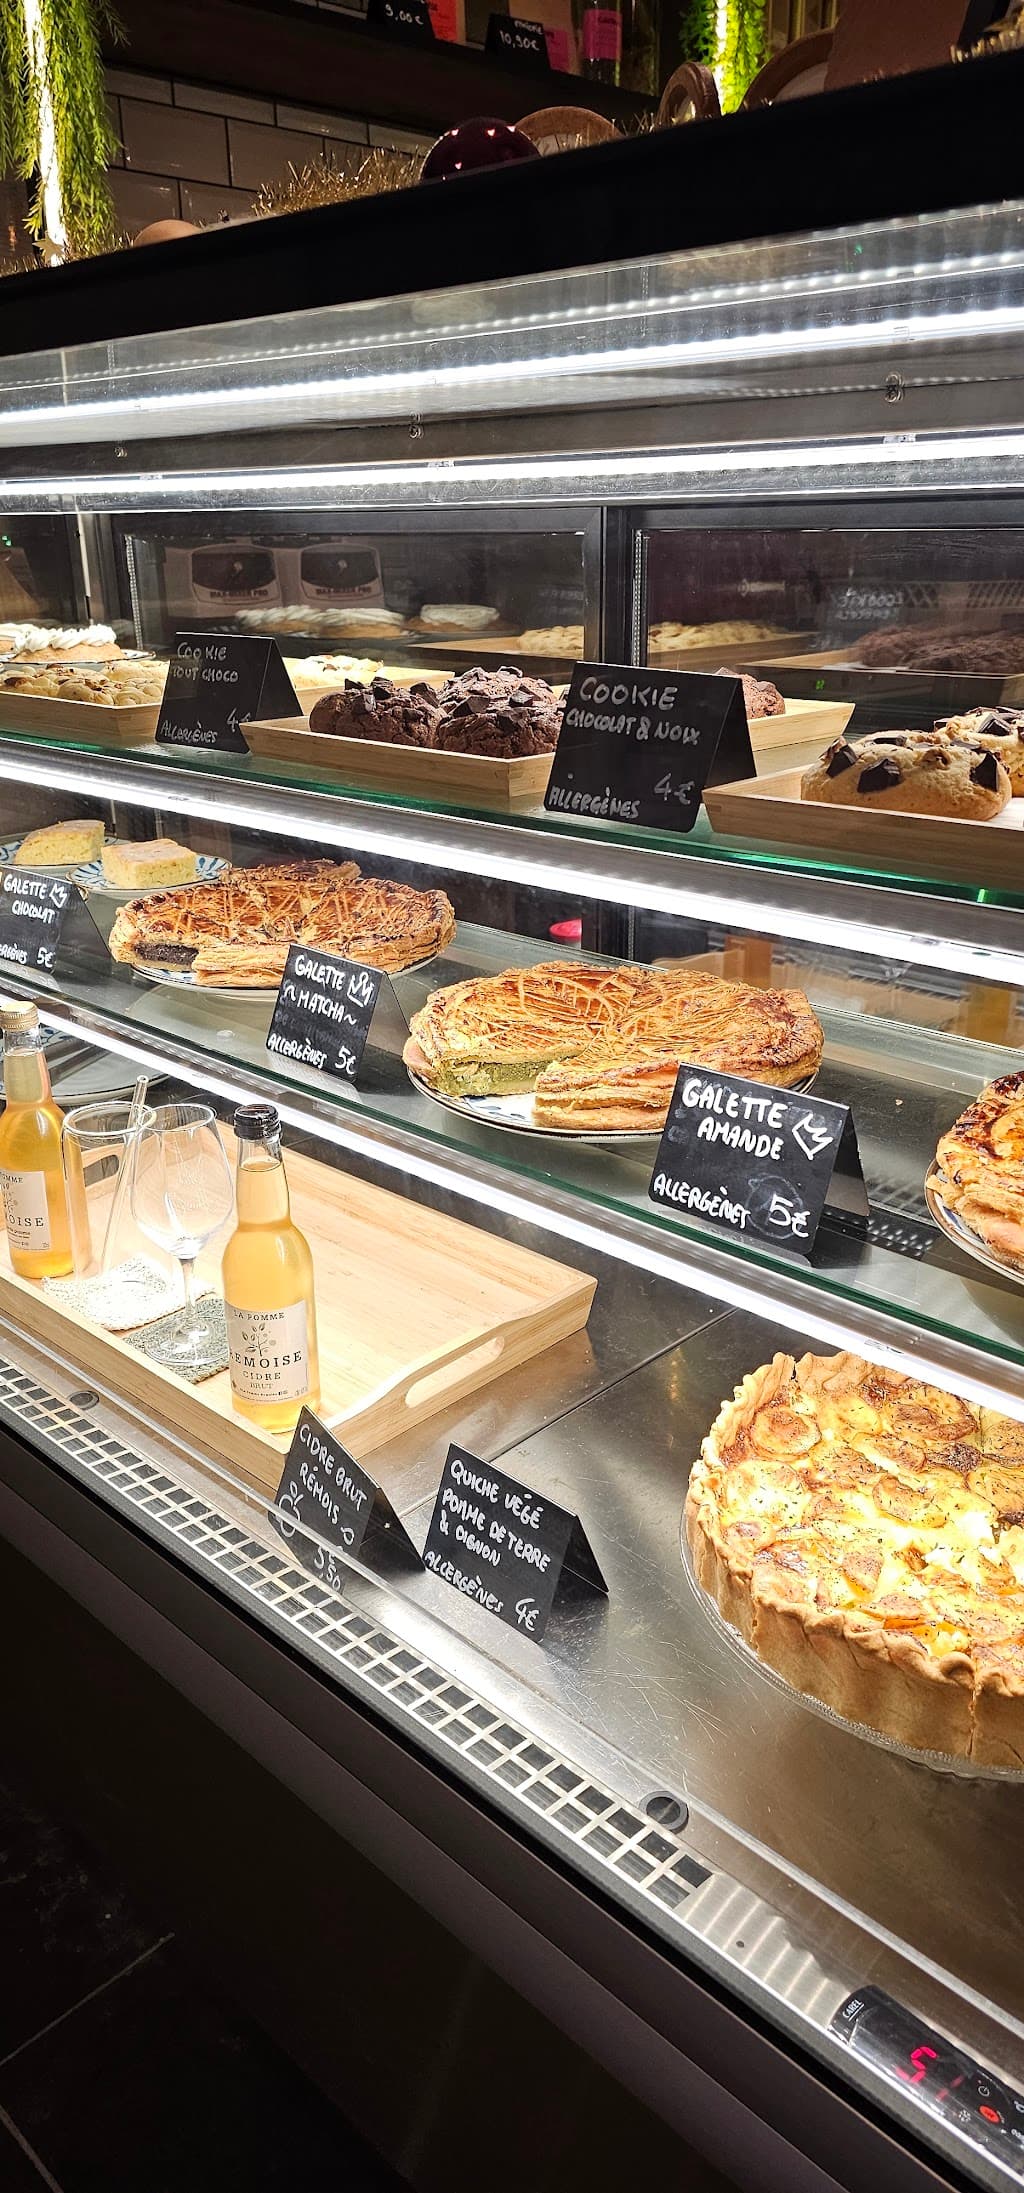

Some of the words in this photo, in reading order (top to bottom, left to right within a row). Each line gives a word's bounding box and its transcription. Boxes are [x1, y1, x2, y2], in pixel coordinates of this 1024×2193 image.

[176, 641, 228, 662] COOKIE
[170, 665, 200, 682] TOUT
[201, 667, 239, 683] CHOCO
[578, 675, 679, 711] COOKIE
[565, 706, 636, 736] CHOCOLAT
[635, 715, 651, 741] &
[654, 721, 701, 745] NOIX
[548, 786, 641, 820] ALLERGÈNES
[653, 772, 696, 806] 4€
[3, 872, 48, 900] GALETTE
[11, 899, 56, 924] CHOCOLAT
[36, 946, 55, 968] 5€
[294, 953, 346, 991] GALETTE
[267, 1032, 328, 1070] ALLERGÈNES
[334, 1045, 358, 1076] 5€
[681, 1077, 789, 1129] GALETTE
[696, 1116, 785, 1161] AMANDE
[653, 1172, 751, 1230] ALLERGÈNES
[768, 1193, 811, 1238] 5€
[233, 1309, 244, 1319] LA
[246, 1311, 286, 1321] POMME
[242, 1370, 282, 1381] CIDRE
[299, 1423, 335, 1475] CIDRE
[335, 1467, 368, 1512] BRUT
[299, 1462, 341, 1525] RÉMOIS
[450, 1458, 501, 1503] QUICHE
[505, 1492, 545, 1530] VÉGÉ
[438, 1509, 449, 1536] &
[455, 1524, 502, 1568] OIGNON
[441, 1487, 486, 1531] POMME
[488, 1520, 506, 1544] DE
[508, 1531, 552, 1573] TERRE
[424, 1549, 504, 1614] ALLERGÈNES
[514, 1597, 540, 1632] 4€
